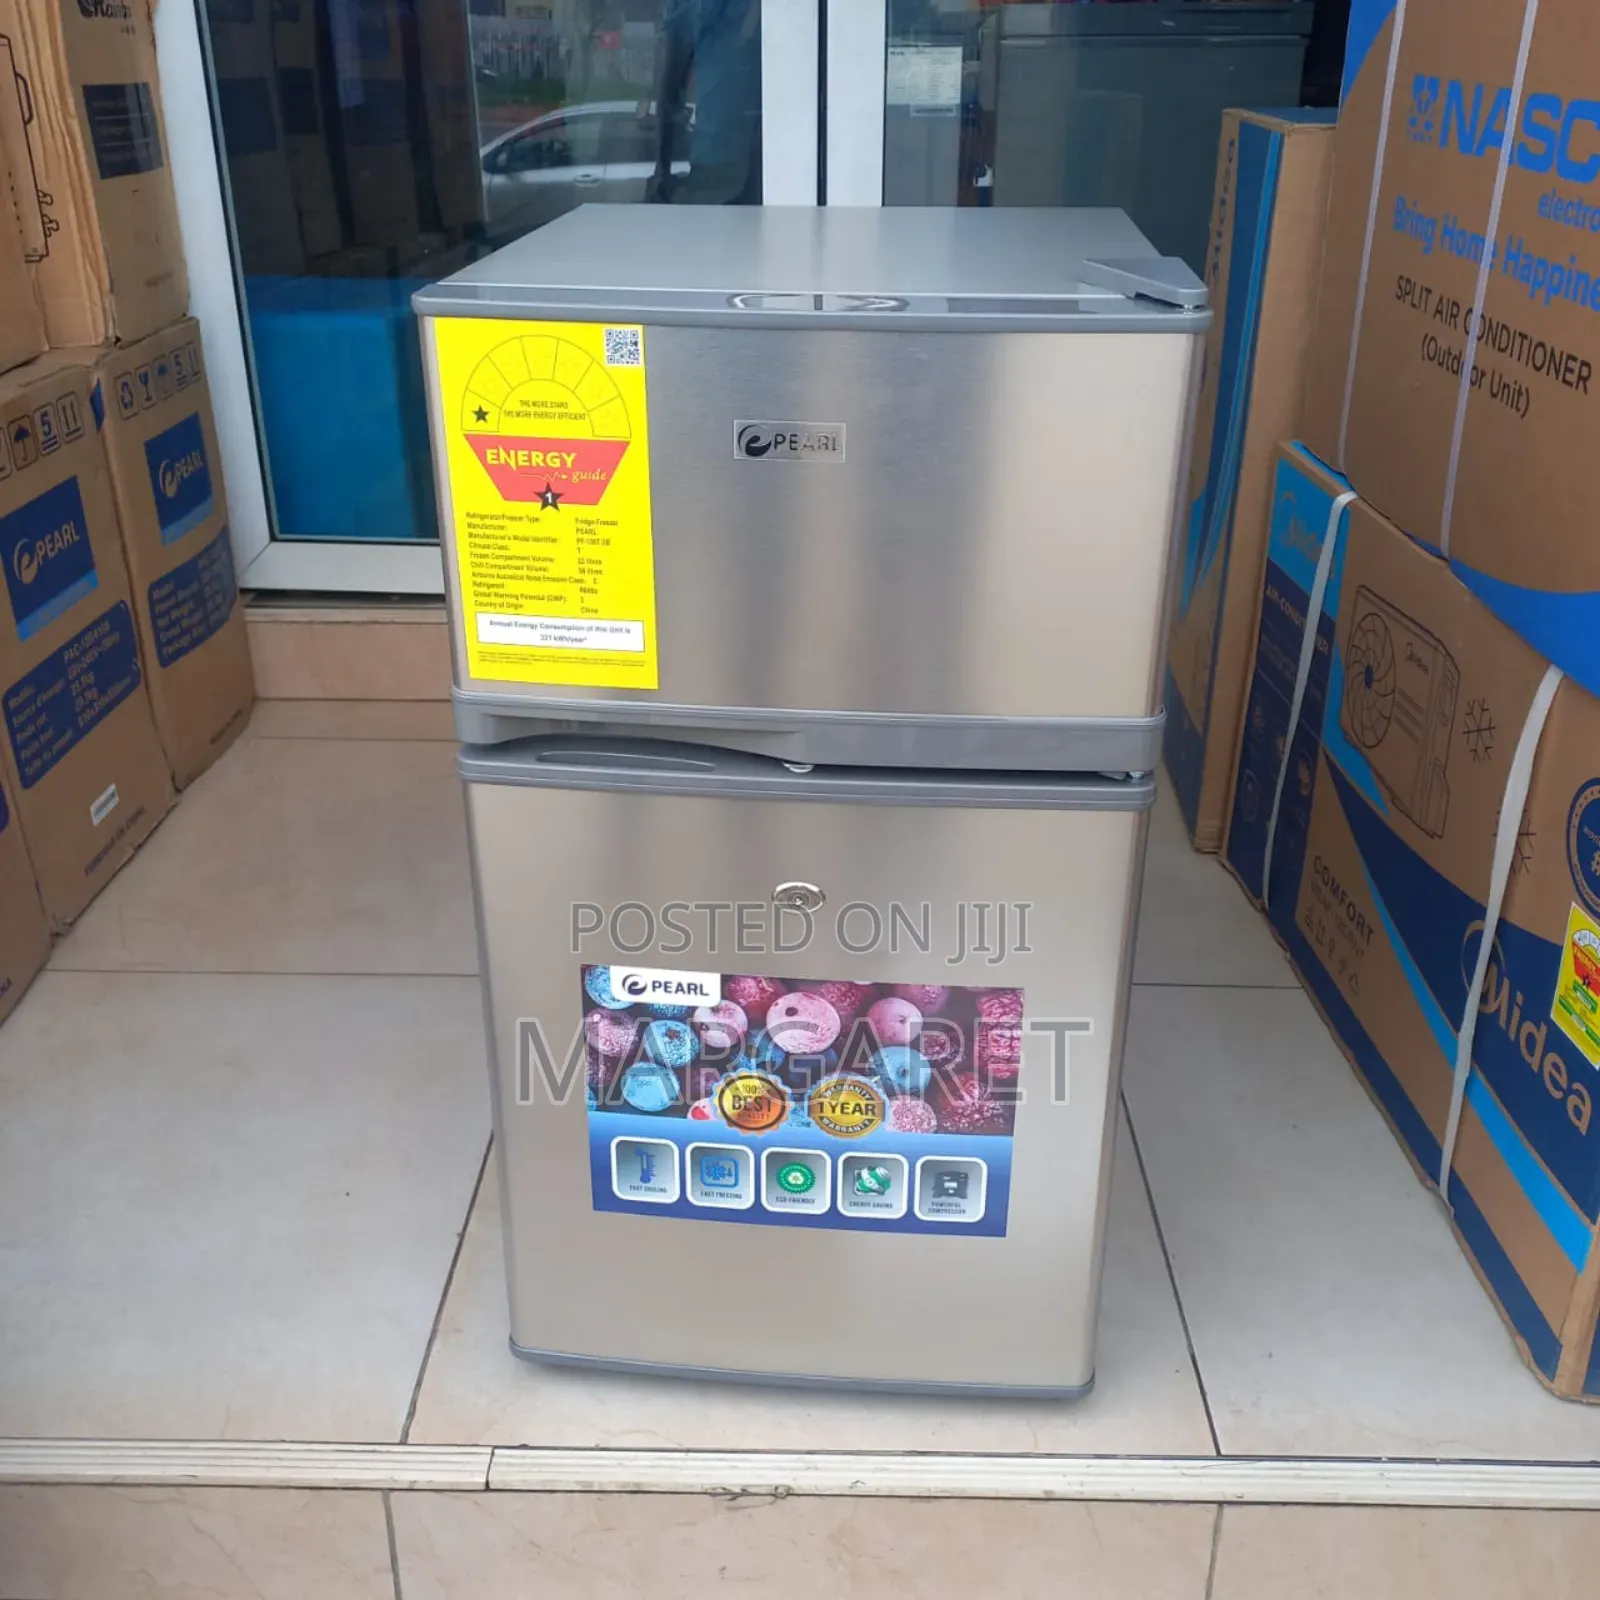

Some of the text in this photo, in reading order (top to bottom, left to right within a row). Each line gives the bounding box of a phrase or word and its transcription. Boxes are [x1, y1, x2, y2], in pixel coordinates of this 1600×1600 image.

[1392, 195, 1438, 255] Bring
[1395, 274, 1432, 313] SPLIT
[1433, 293, 1461, 331] AIR
[1489, 368, 1531, 420] Unit)
[773, 433, 841, 452] PEARL
[485, 445, 577, 471] ENERGY
[571, 468, 607, 483] guide
[545, 492, 553, 503] 1
[576, 527, 596, 536] PEARL
[36, 519, 80, 567] PEARL
[580, 606, 599, 615] China
[514, 620, 538, 631] Energy
[539, 622, 585, 633] Consumption
[1313, 855, 1375, 946] COMFORT
[650, 979, 710, 998] PEARL
[1478, 961, 1592, 1137] Midea
[731, 1094, 773, 1112] BEST
